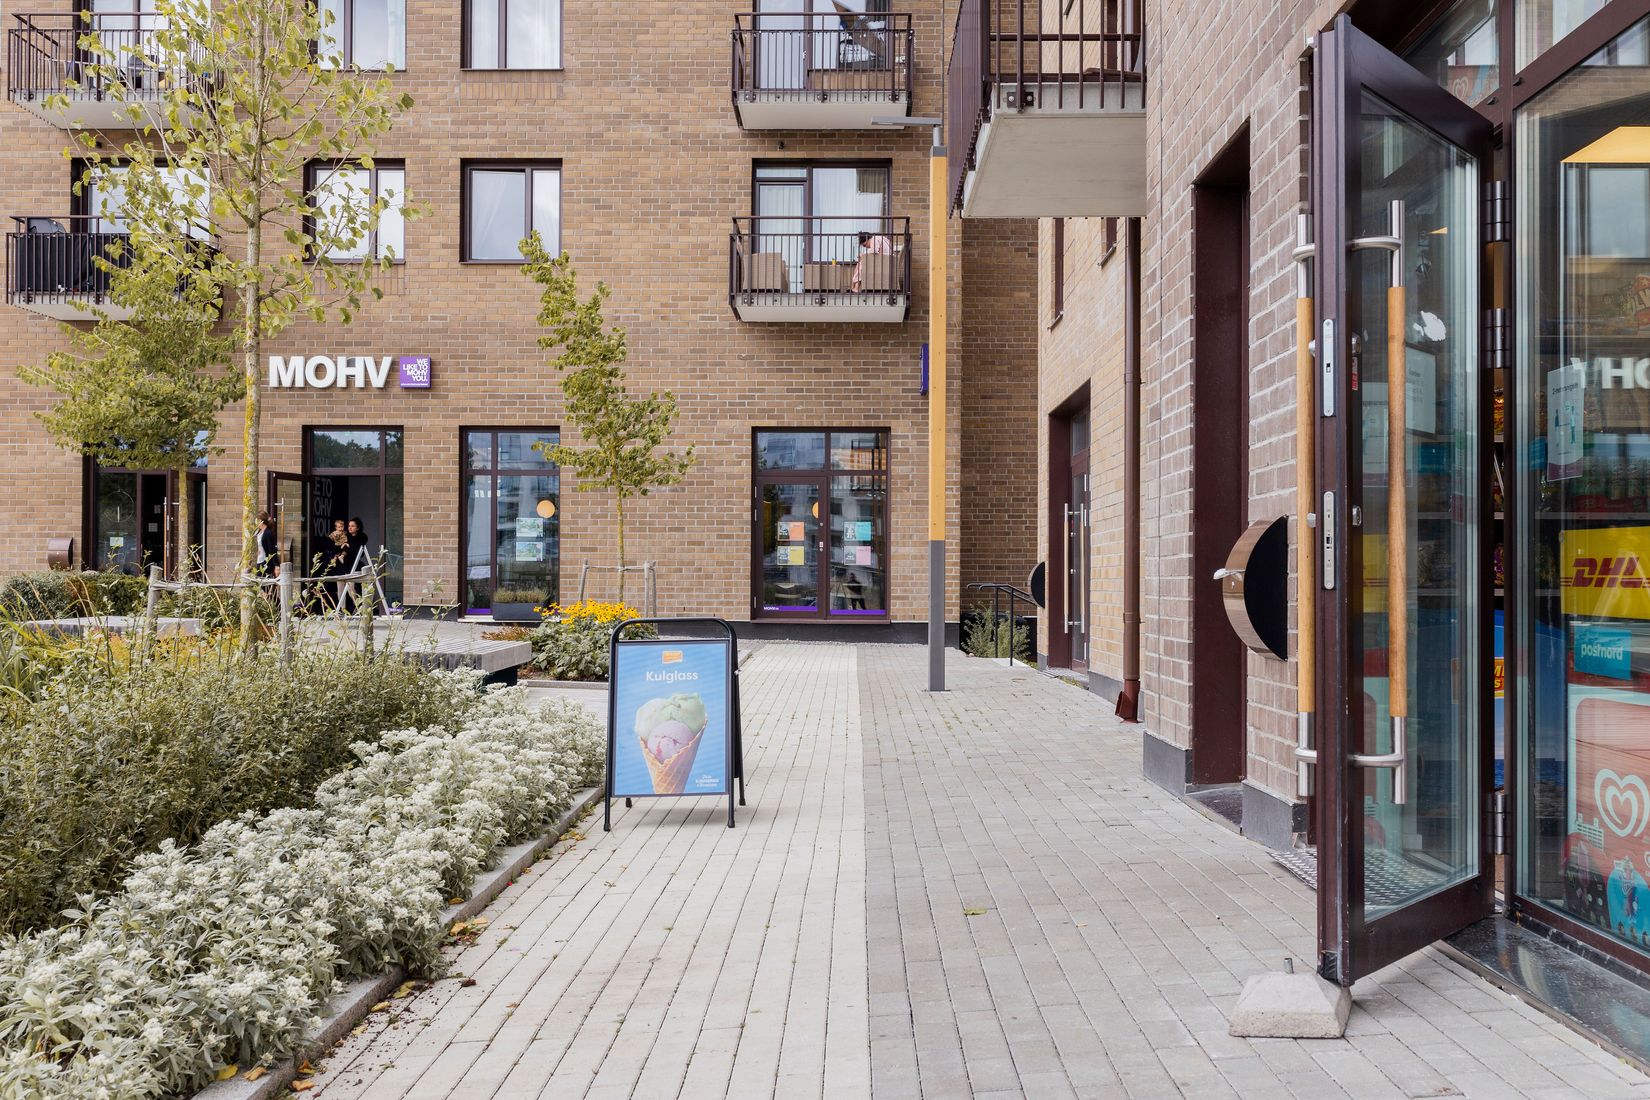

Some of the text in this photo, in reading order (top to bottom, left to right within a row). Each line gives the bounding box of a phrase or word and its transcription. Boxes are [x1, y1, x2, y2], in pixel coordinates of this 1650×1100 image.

[269, 355, 392, 388] MOHV
[402, 363, 418, 371] LIKE
[312, 496, 332, 517] OHV
[1572, 557, 1643, 588] DHL
[1580, 643, 1623, 660] postnord
[646, 671, 698, 683] Kulglass
